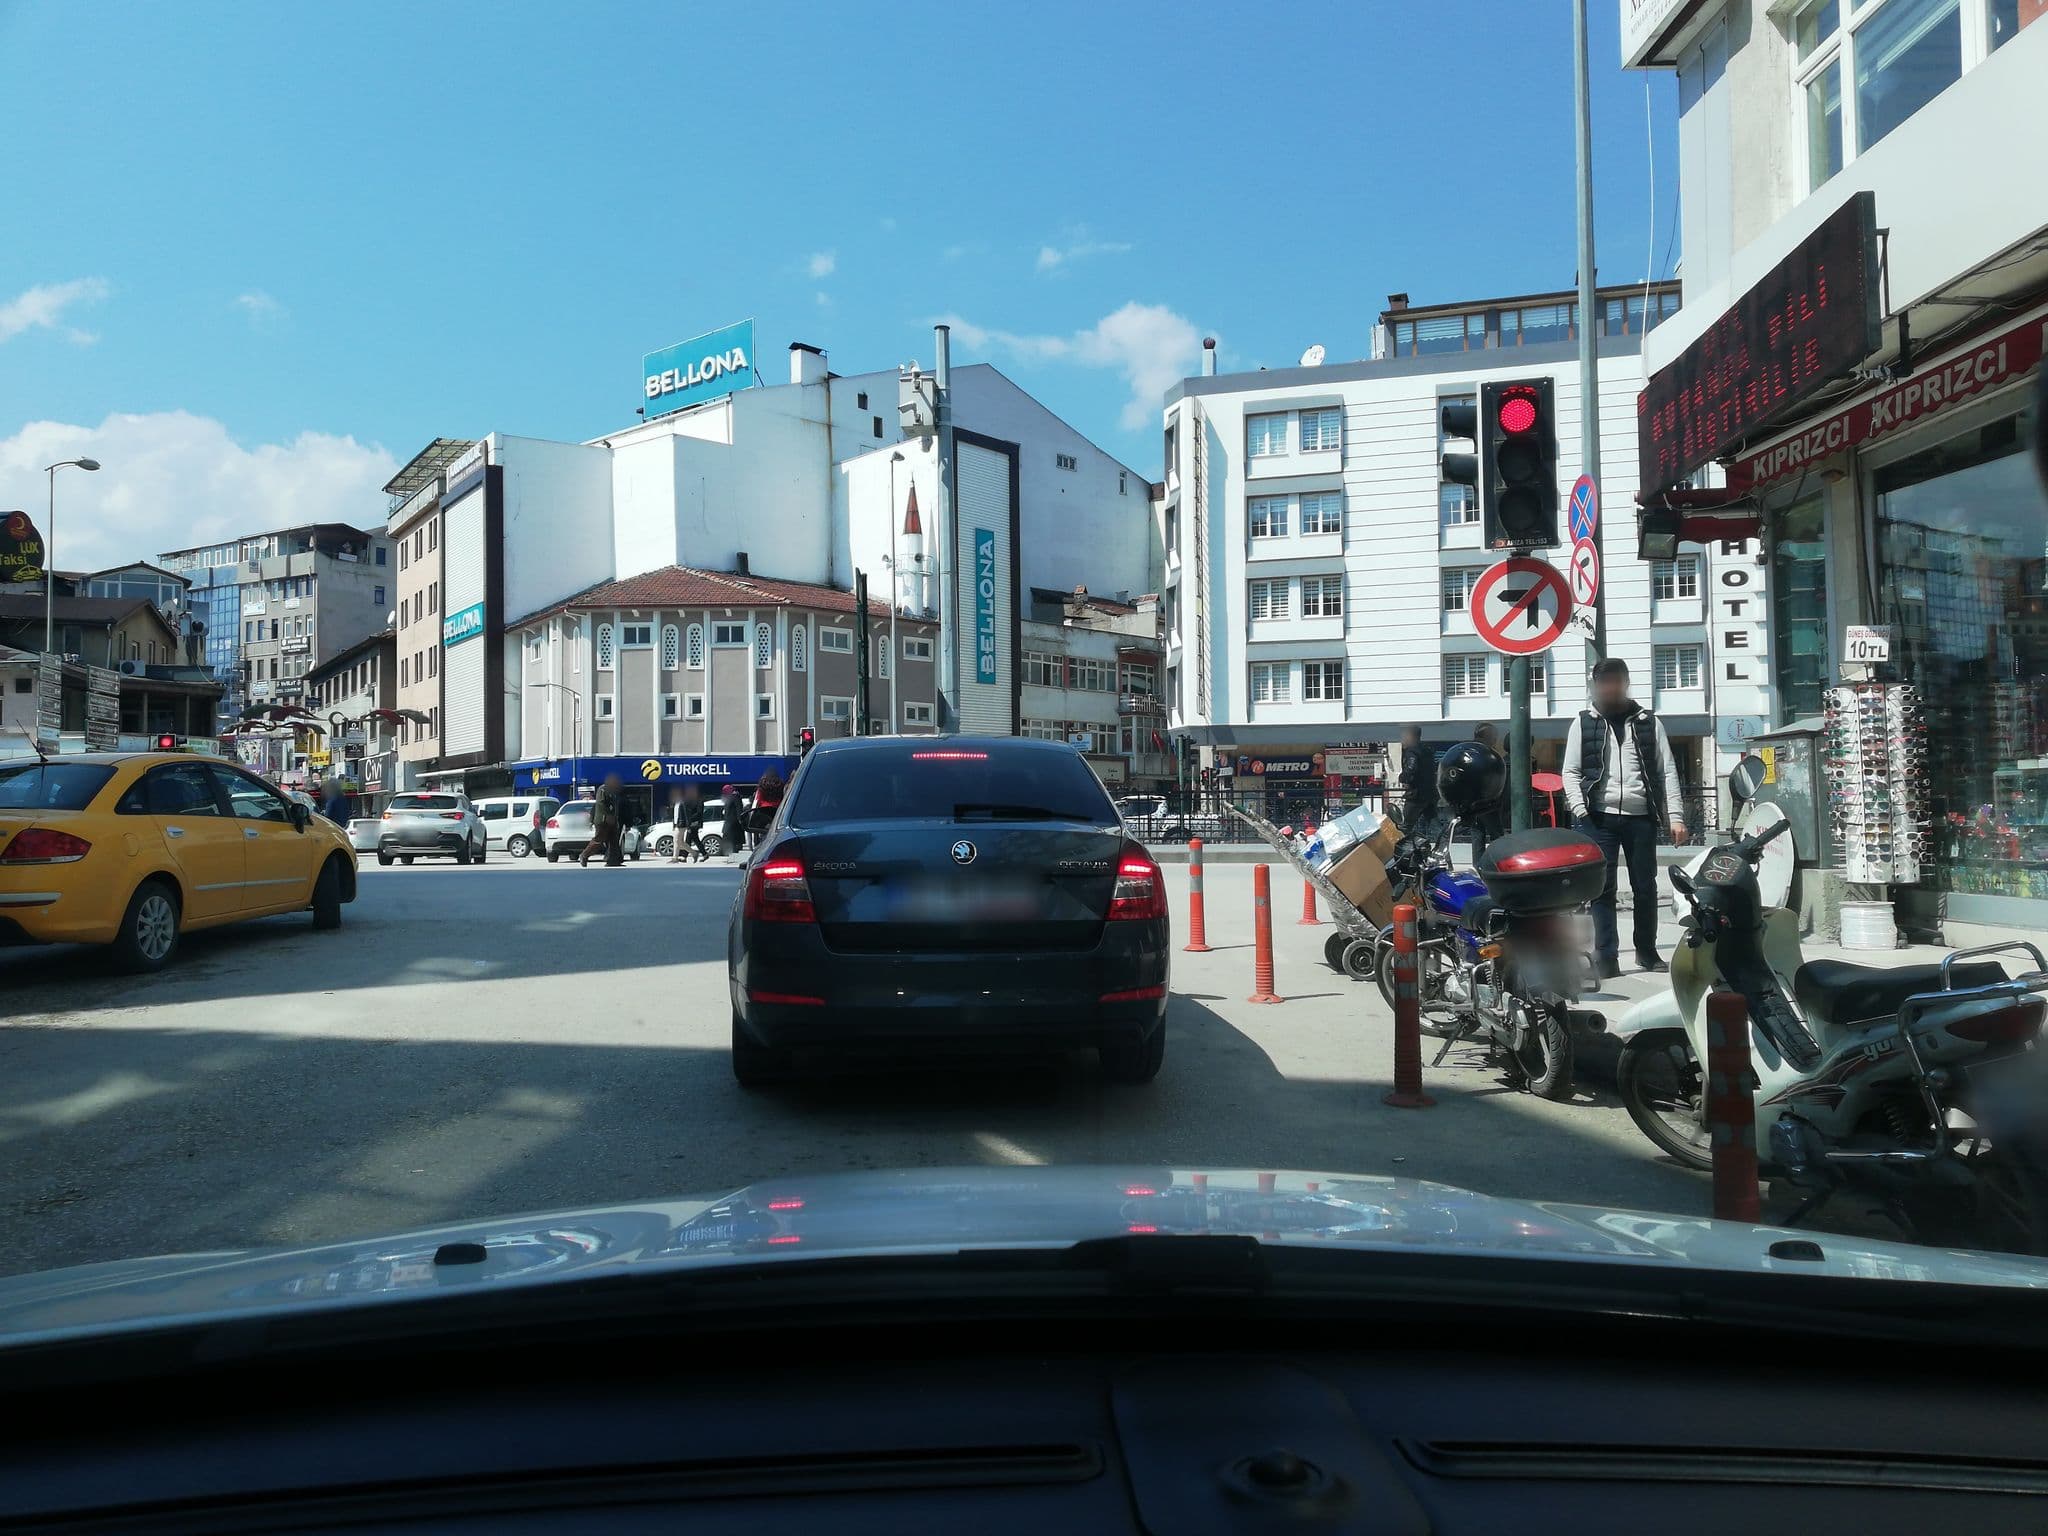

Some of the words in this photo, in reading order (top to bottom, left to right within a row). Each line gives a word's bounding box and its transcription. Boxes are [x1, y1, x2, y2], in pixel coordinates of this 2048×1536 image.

[645, 347, 749, 398] BELLONA
[1874, 341, 2007, 429] KIPRIZCI
[1752, 415, 1850, 483] KIPRIZCI
[443, 608, 481, 641] BELLONA
[979, 539, 994, 675] BELLONA
[1721, 540, 1749, 680] HOTEL
[666, 763, 731, 776] TURKCELL
[1265, 761, 1310, 773] METRO
